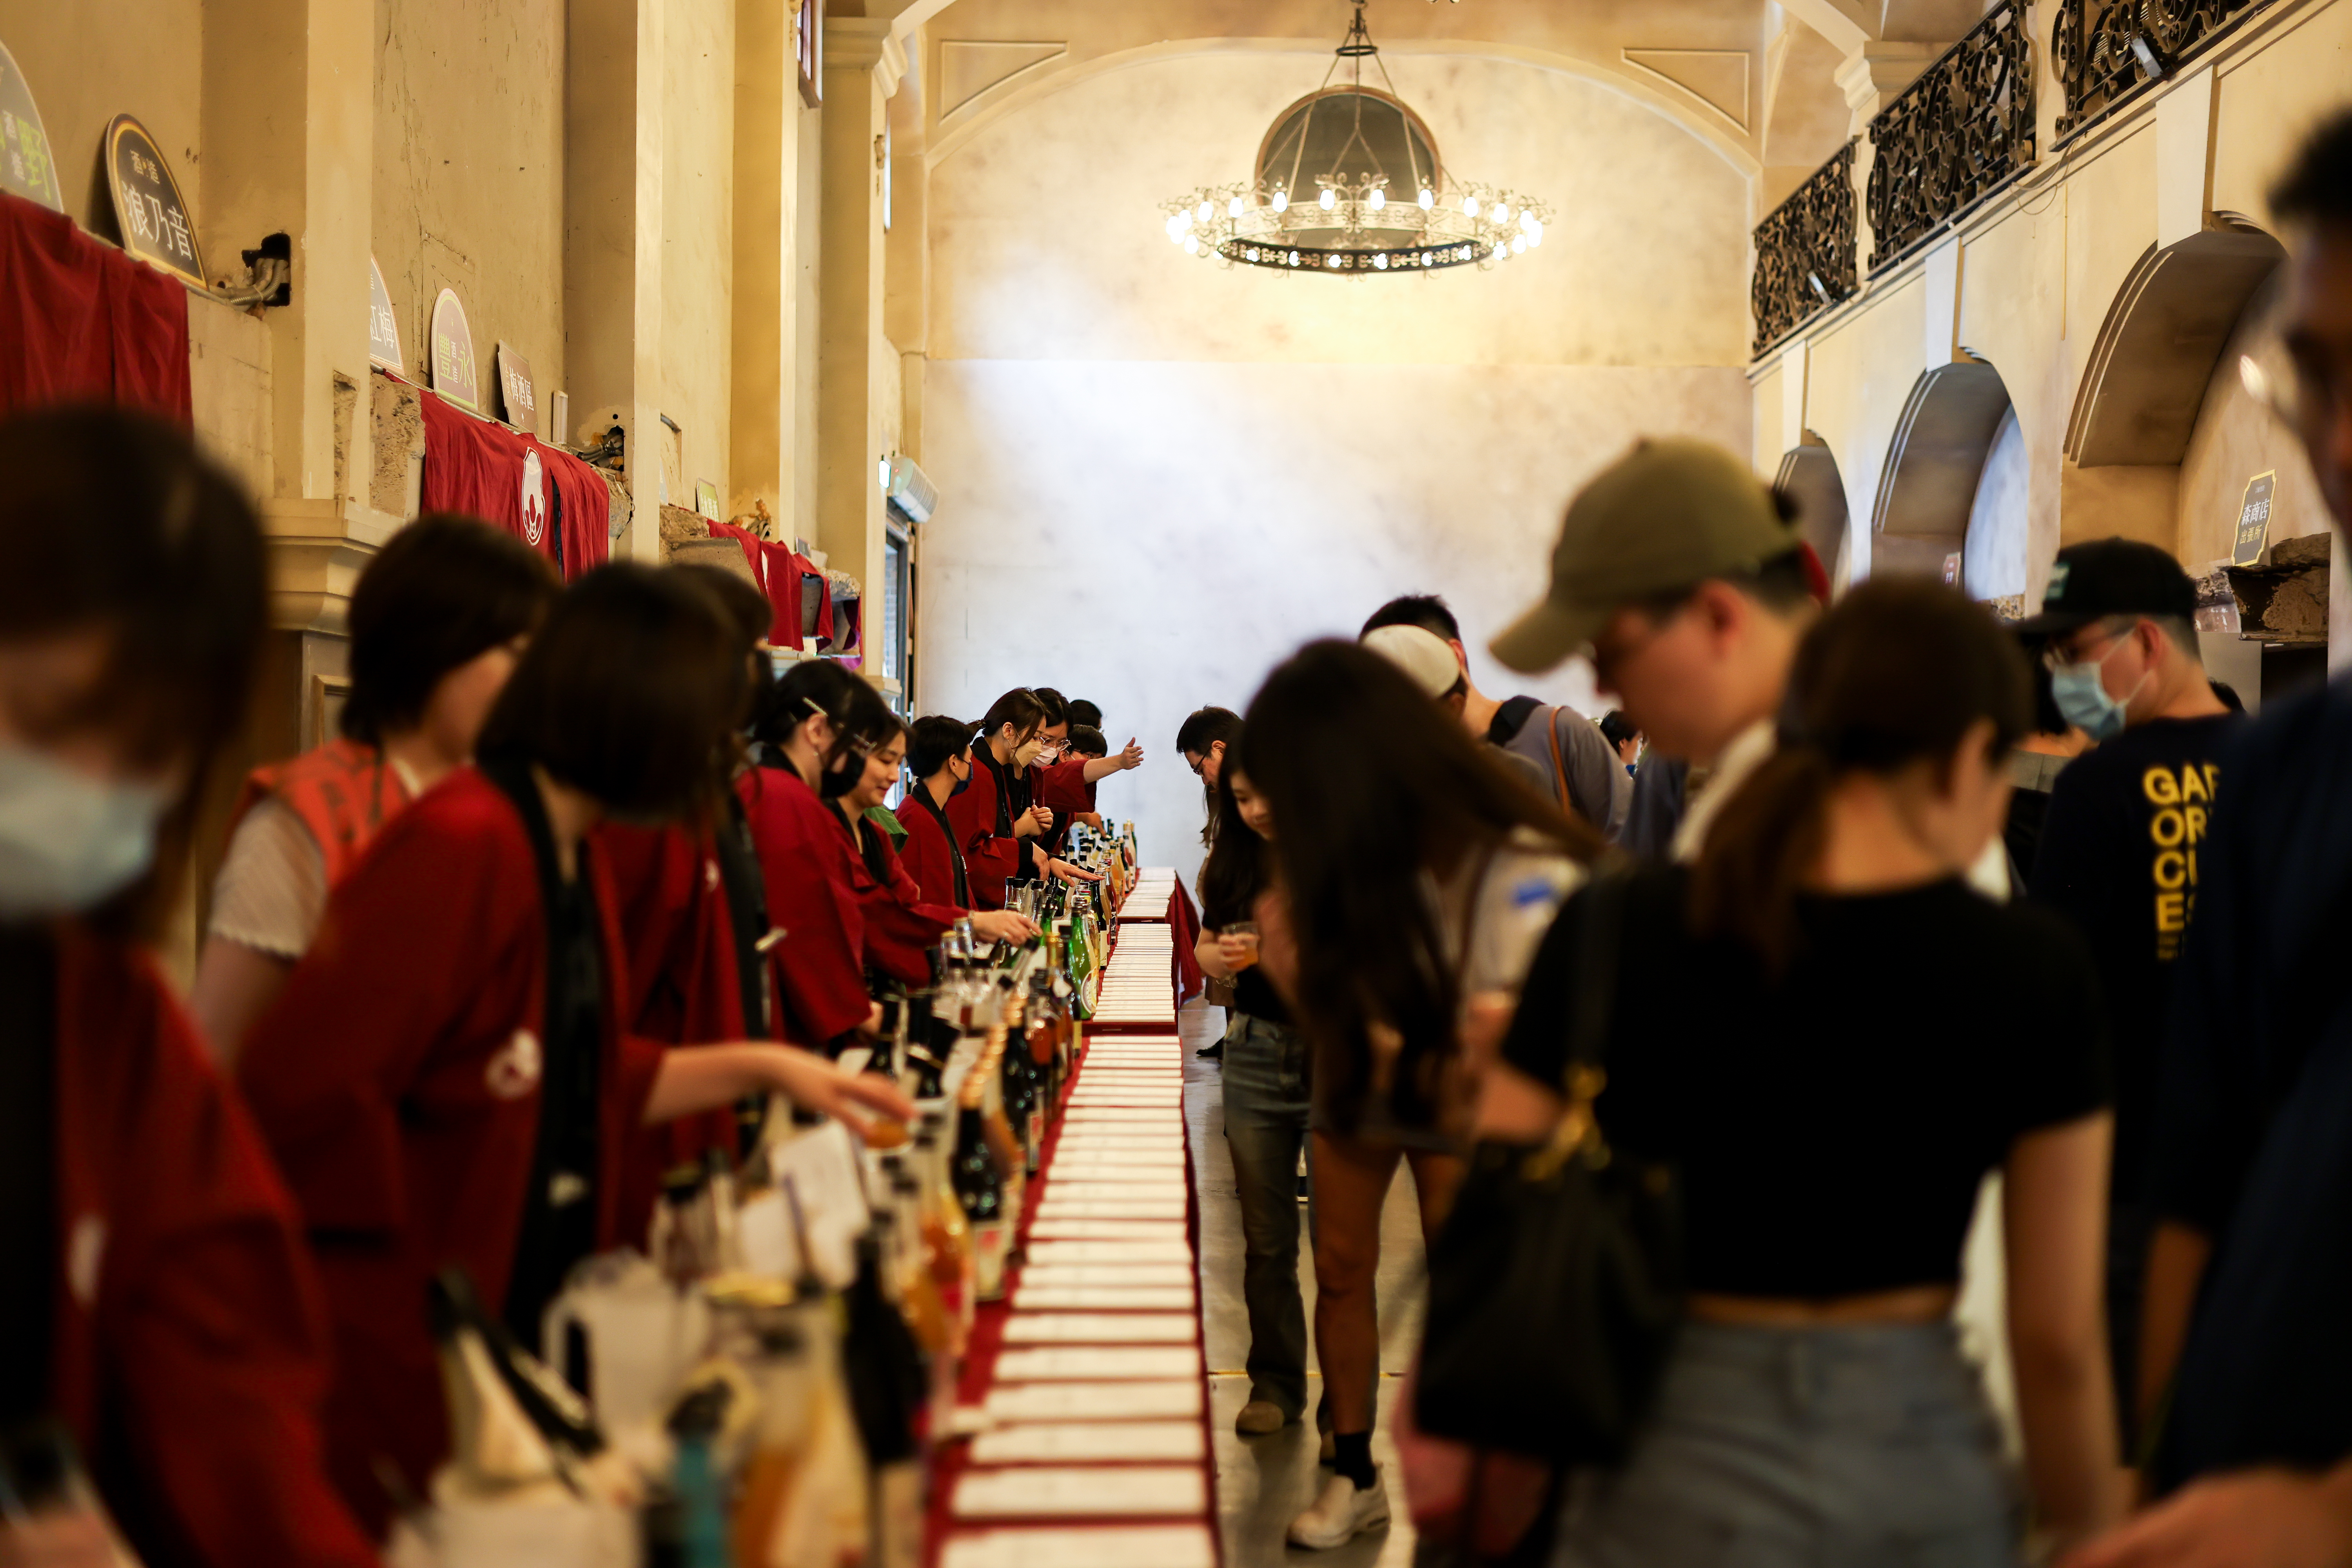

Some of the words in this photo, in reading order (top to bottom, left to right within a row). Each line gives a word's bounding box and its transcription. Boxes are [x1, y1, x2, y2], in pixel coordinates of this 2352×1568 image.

[122, 181, 192, 260] 浪乃音
[510, 366, 534, 411] 梅酒區
[2241, 498, 2270, 526] 森商店
[2239, 524, 2262, 544] 出張所
